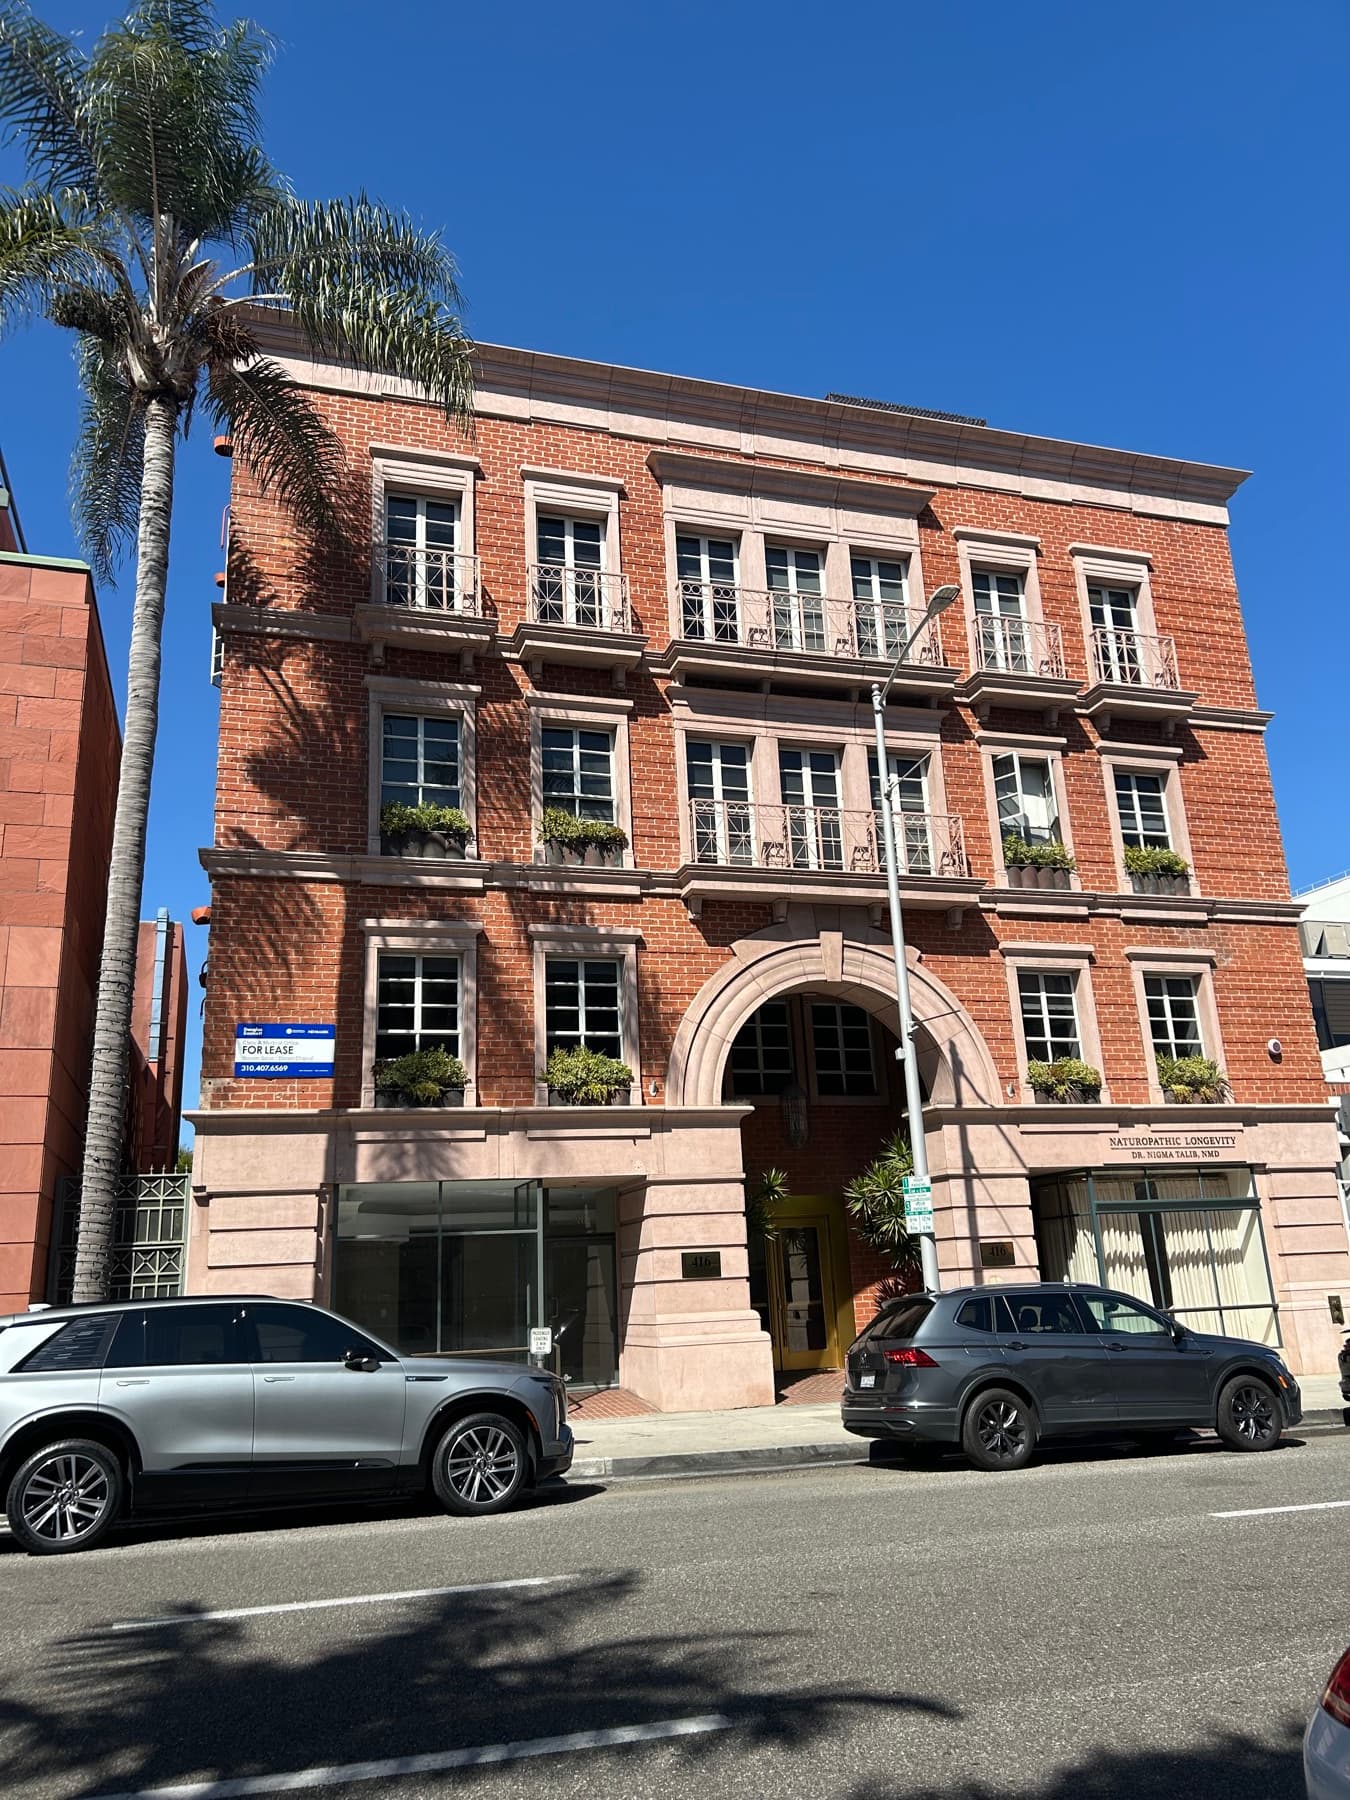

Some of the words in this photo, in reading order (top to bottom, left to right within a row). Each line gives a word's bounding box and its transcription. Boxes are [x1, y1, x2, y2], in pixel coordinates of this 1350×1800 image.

[242, 1046, 262, 1054] FOR
[264, 1045, 294, 1055] LEASE
[1109, 1137, 1181, 1147] NATUROPATHIC
[1185, 1136, 1236, 1146] LONGEVITY
[1131, 1151, 1146, 1160] DR.
[1147, 1151, 1174, 1159] NIGMA
[1175, 1150, 1201, 1159] TALIB,
[1202, 1150, 1220, 1158] NMD
[989, 1245, 1007, 1256] 416
[692, 1255, 711, 1267] 416
